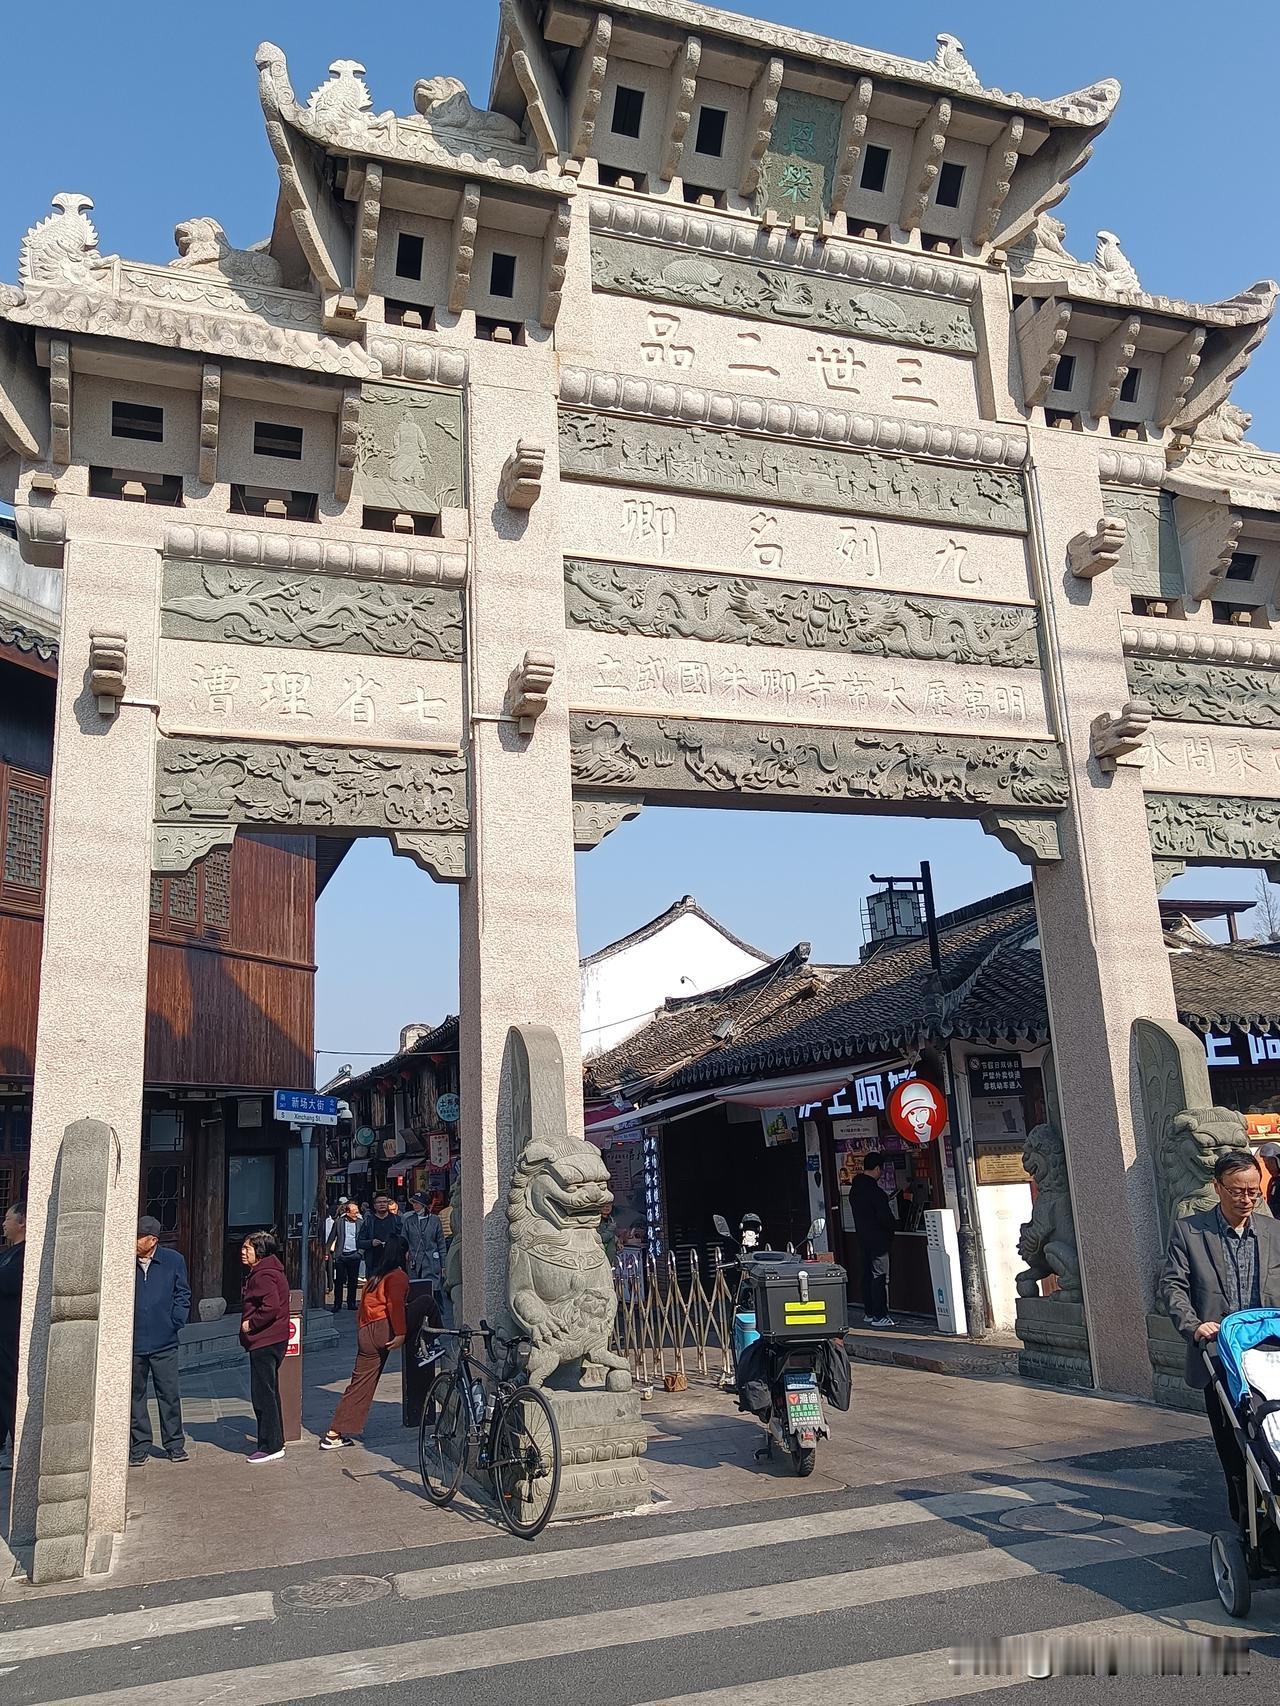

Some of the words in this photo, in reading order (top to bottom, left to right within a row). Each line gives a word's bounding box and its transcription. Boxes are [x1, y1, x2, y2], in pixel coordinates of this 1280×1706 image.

[291, 1096, 325, 1111] 新场大街
[293, 1112, 315, 1122] Xinchang
